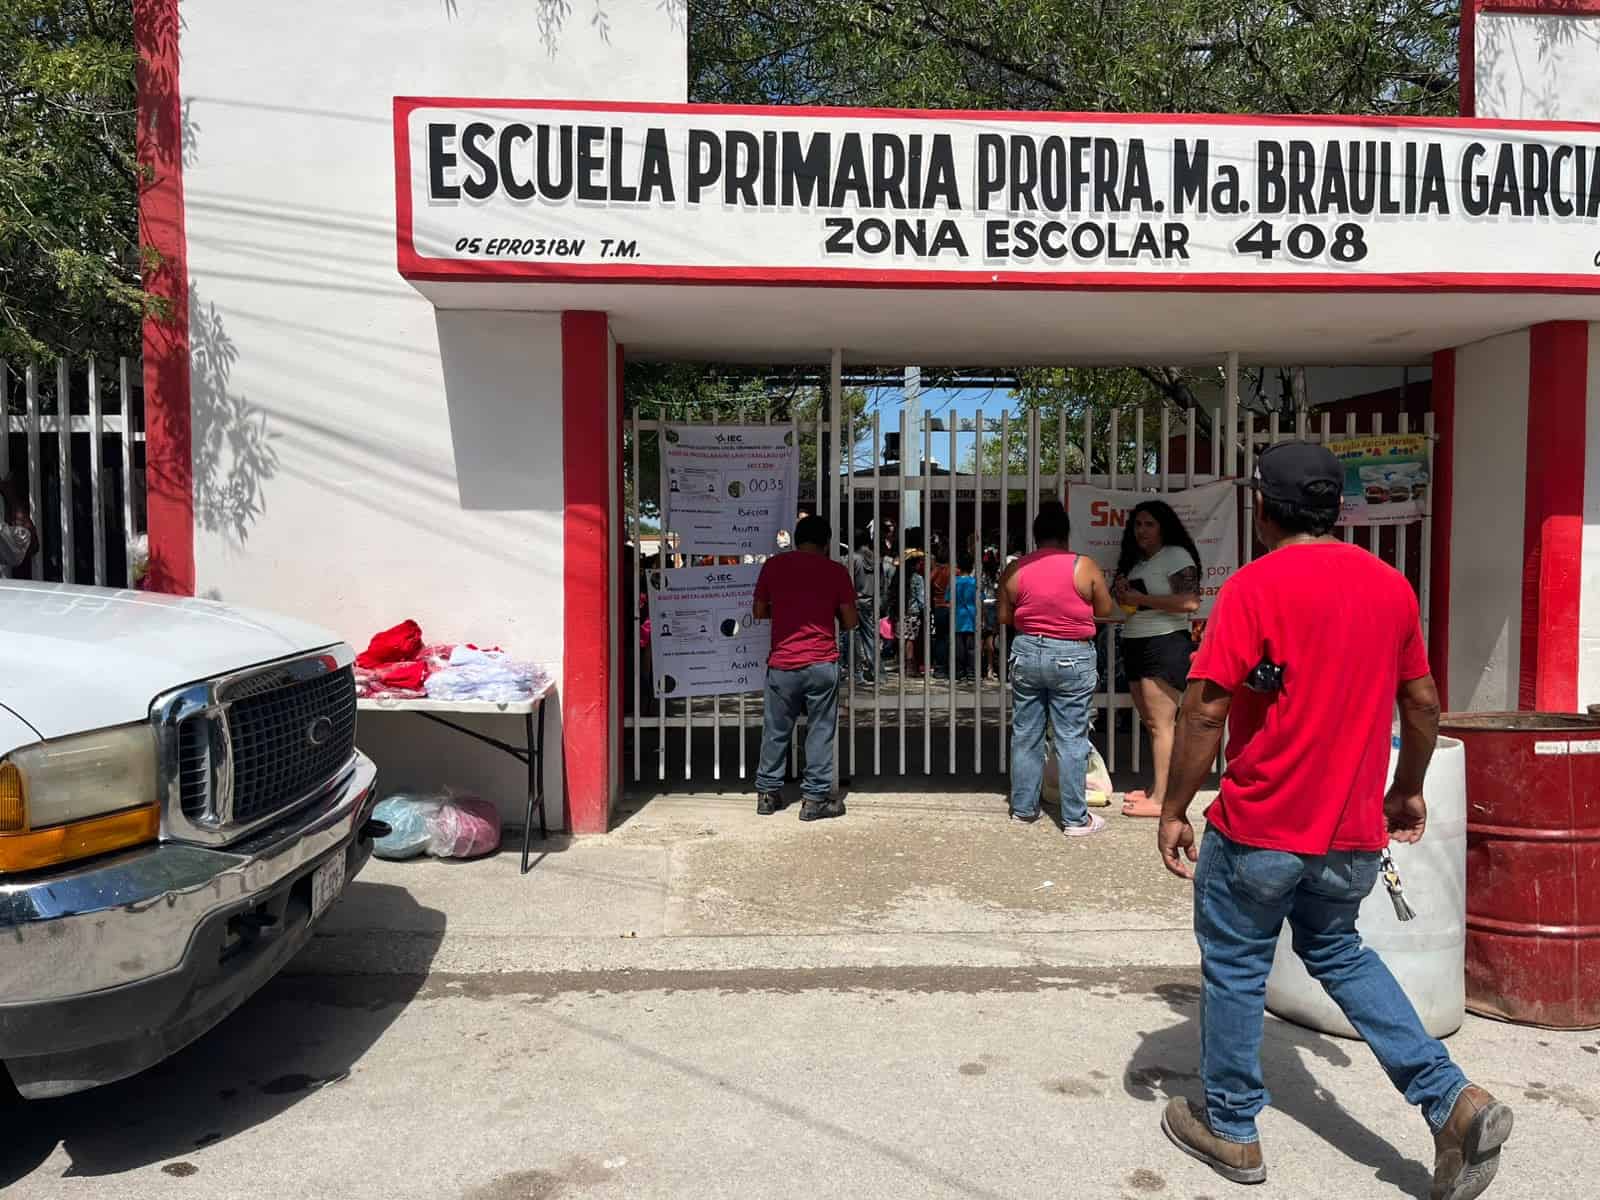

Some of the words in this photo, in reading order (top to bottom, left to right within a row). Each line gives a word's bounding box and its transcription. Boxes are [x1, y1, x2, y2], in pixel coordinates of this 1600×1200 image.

[429, 122, 676, 202] ESCUELA
[687, 129, 962, 209] PRIMARIA
[978, 133, 1164, 213] PROFRA.
[1173, 138, 1250, 214] Ma.
[1258, 140, 1450, 215] BRAULIA
[825, 217, 969, 256] ZONA
[986, 220, 1189, 259] ESCOLAR
[1236, 220, 1368, 262] 408
[600, 239, 641, 258] T.M.
[727, 434, 743, 442] IEC
[717, 574, 733, 582] IEC
[1207, 566, 1232, 579] por
